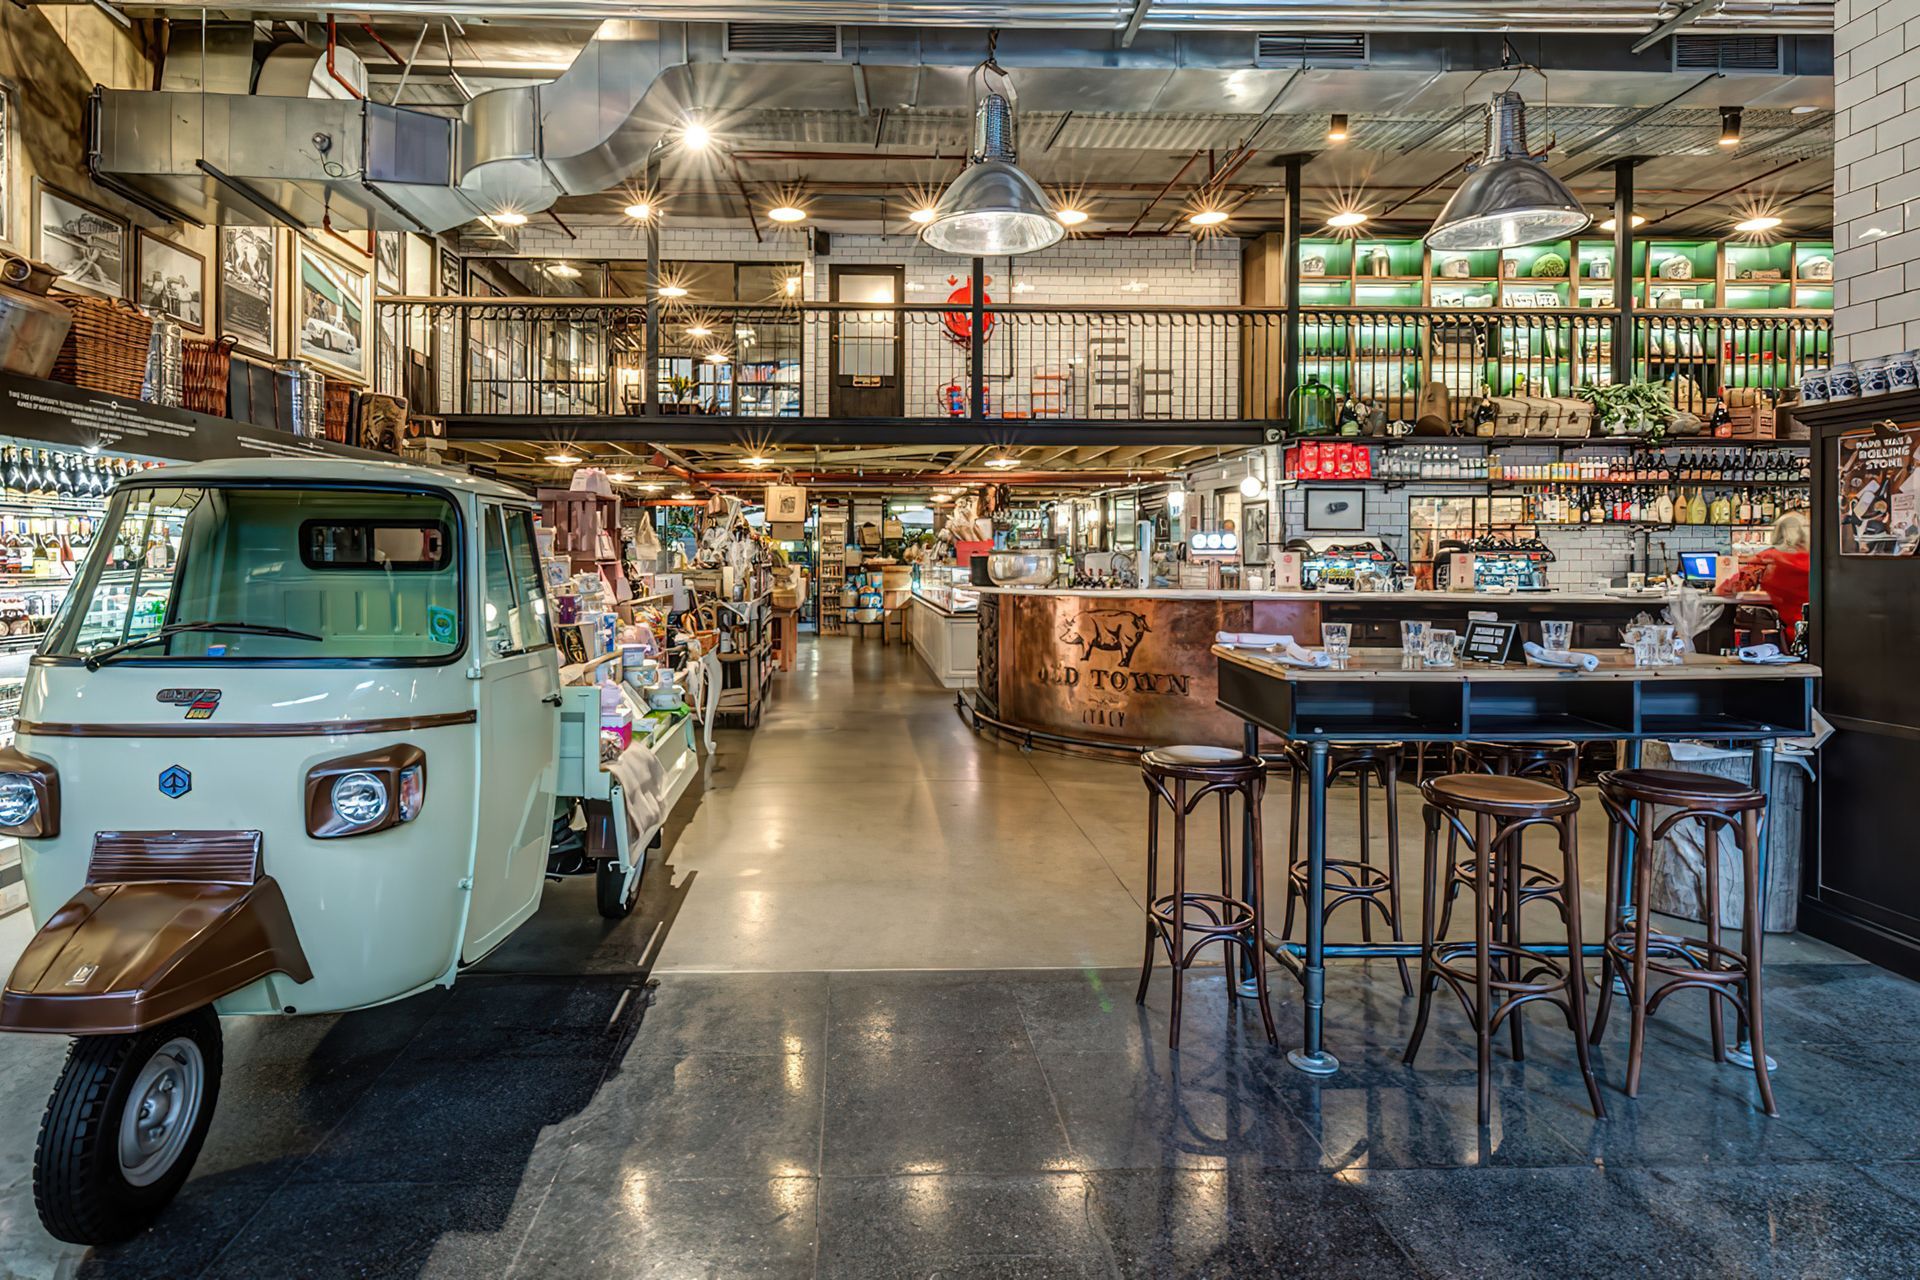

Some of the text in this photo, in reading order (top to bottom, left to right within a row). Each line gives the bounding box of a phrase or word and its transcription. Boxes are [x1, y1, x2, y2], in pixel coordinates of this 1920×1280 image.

[1859, 446, 1910, 459] ROLLING
[1038, 666, 1190, 696] OLD TOWN
